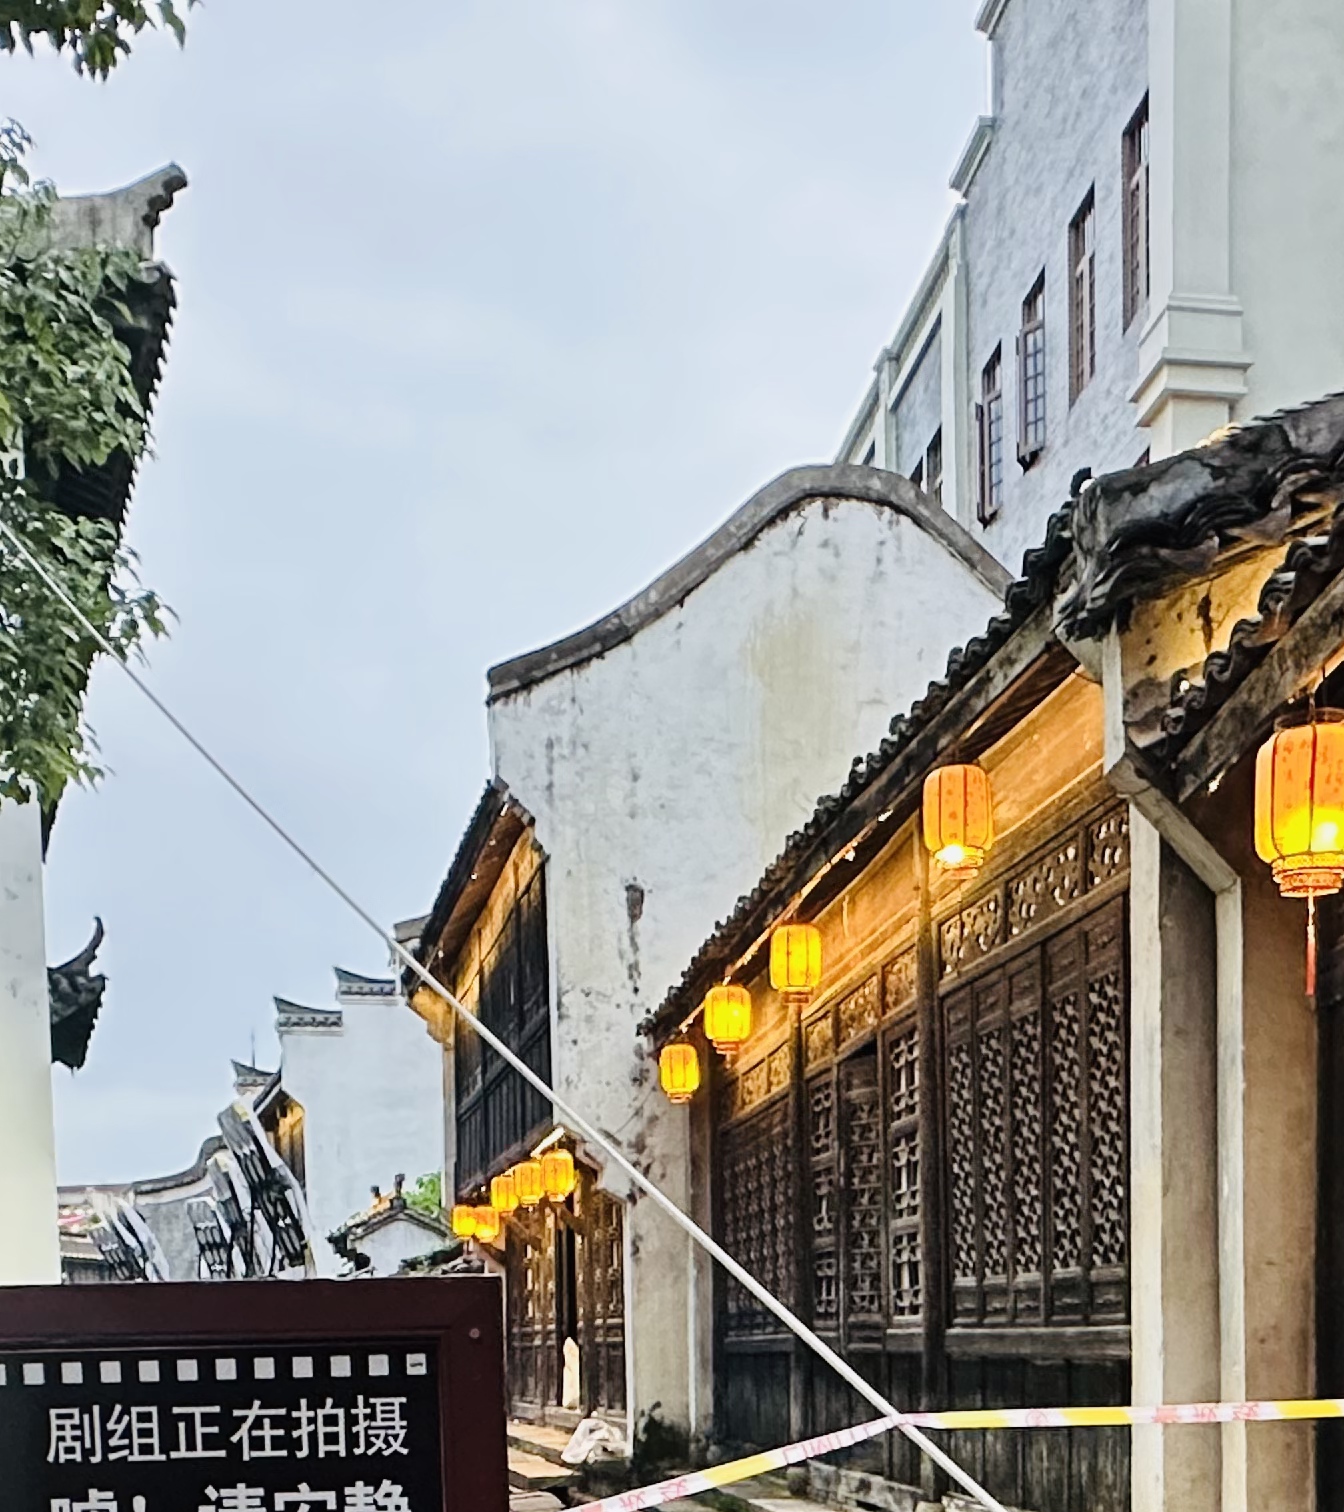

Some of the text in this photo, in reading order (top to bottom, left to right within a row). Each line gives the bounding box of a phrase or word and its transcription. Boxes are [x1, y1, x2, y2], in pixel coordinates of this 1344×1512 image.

[46, 1395, 409, 1463] 剧组正在拍摄
